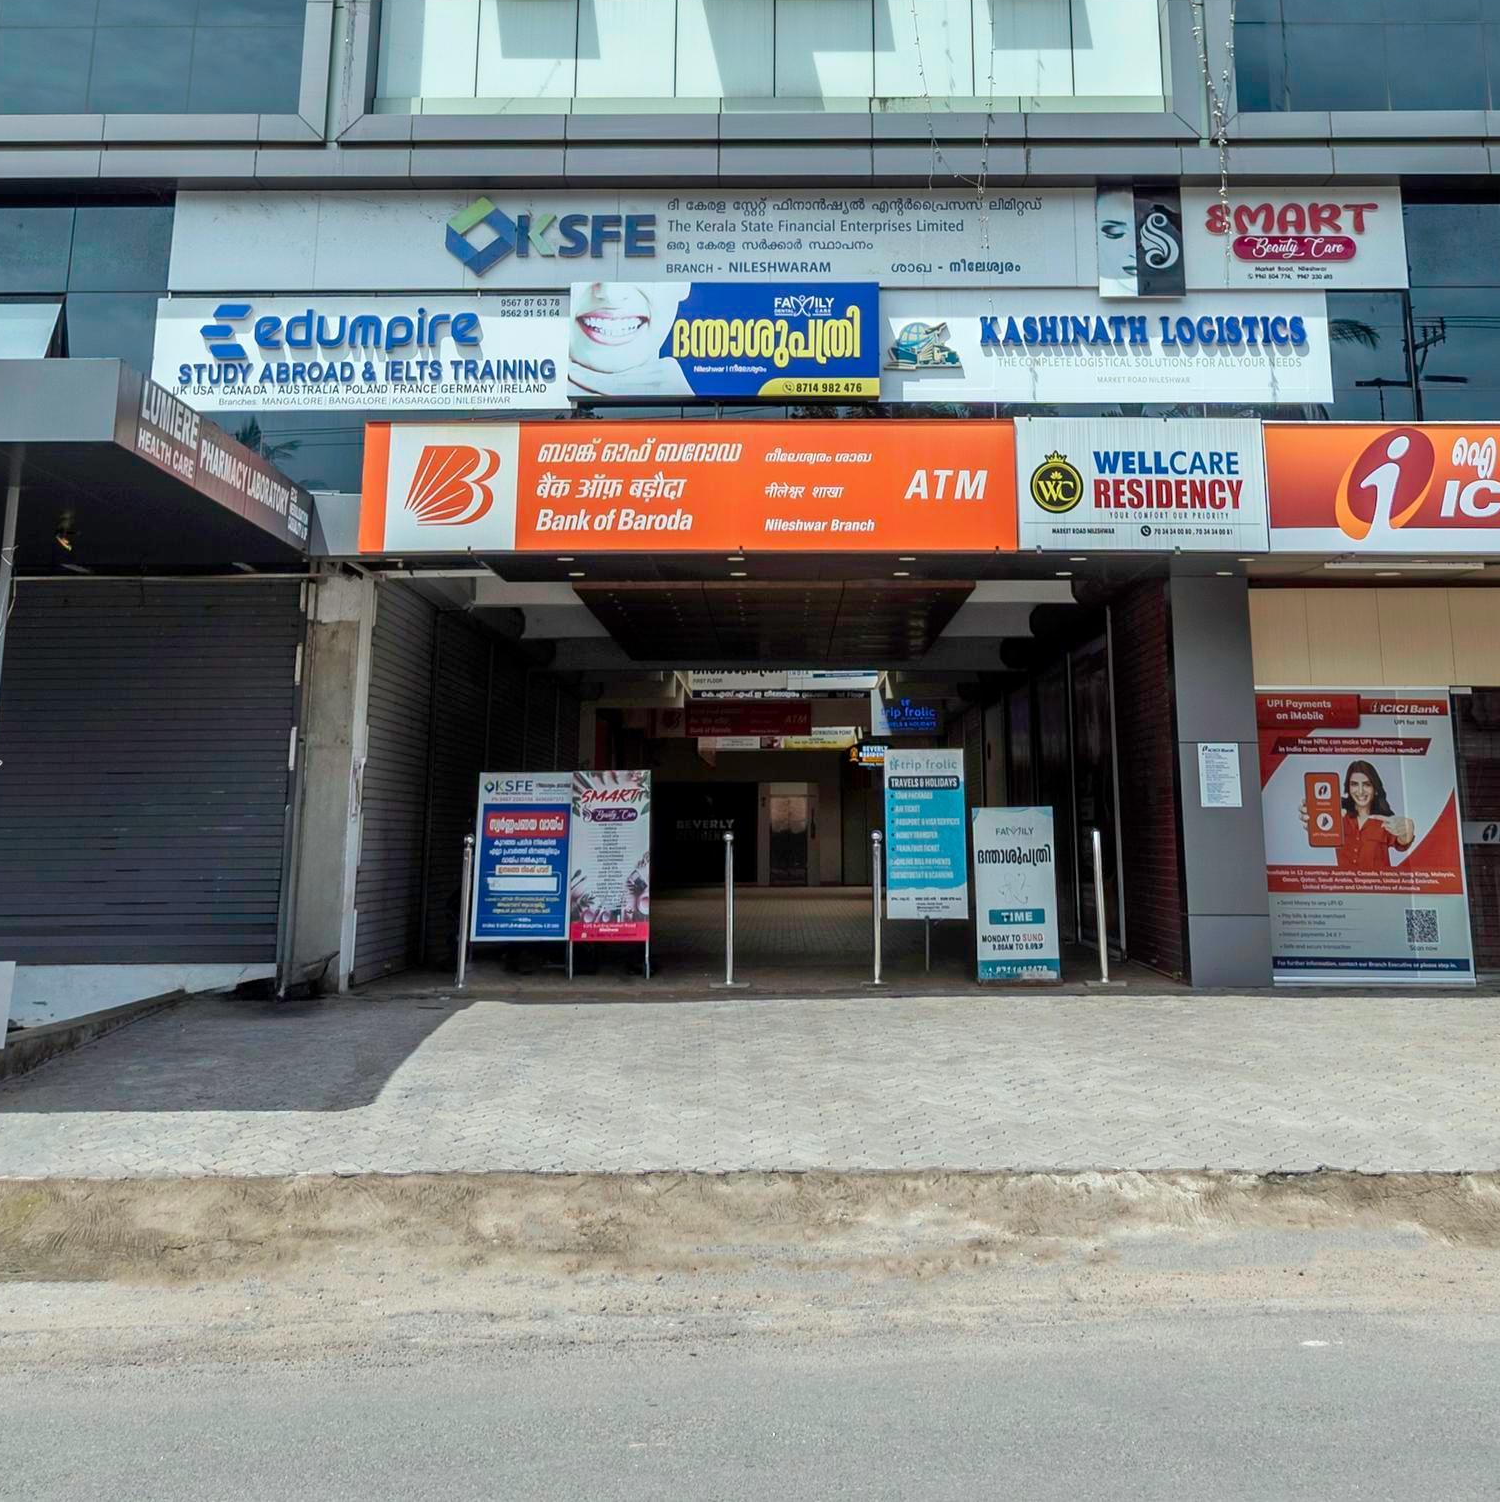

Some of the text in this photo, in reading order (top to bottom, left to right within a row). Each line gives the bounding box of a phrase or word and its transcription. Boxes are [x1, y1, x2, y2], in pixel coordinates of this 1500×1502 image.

[666, 199, 680, 211] ദി
[686, 200, 726, 214] കേരള
[1205, 202, 1379, 235] SMART
[667, 219, 964, 236] The Kerala State Financial Enterprises Limited
[515, 213, 657, 258] KSFE
[666, 241, 690, 254] ഒരു
[697, 241, 736, 252] കേരള
[1245, 237, 1345, 259] Beauty Care
[666, 261, 832, 274] BRANCH NILESHWARAM
[891, 263, 933, 274] ശാഖ
[980, 315, 1307, 347] KASHINATH LOGISTICS
[998, 357, 1302, 368] THE COMPLETE LOGISTICAL SOLUTIONS FOR ALL YOUR NEEDS
[178, 358, 556, 385] STUDY ABROAD & IELTS TRAINING
[173, 384, 547, 395] UK USA CANADA AUSTRALIA POLAND FRANCE GERMANY IRELAND
[796, 383, 863, 393] 8714 982 476
[140, 379, 200, 450] LUMIERE
[137, 427, 195, 479] HEALTH CARE
[537, 437, 601, 463] ബാങ്ക്
[601, 438, 653, 463] ഓഫ്
[1092, 450, 1240, 475] WELLCARE
[200, 439, 249, 492] PHARMACY
[247, 465, 290, 517] LABORATORY
[904, 469, 989, 500] ATM
[535, 471, 571, 499] बैंक
[629, 471, 687, 504] बड़ौदा
[811, 484, 844, 498] शाखा
[1093, 478, 1244, 510] RESIDENCY
[535, 508, 693, 532] Bank of Baroda
[764, 518, 875, 532] Nileshwar Branch
[1266, 700, 1332, 710] UPI Payments
[1379, 704, 1440, 714] ICICI Bank
[1290, 712, 1324, 721] iMobile
[926, 758, 957, 770] frolic
[495, 780, 534, 792] KSFE
[890, 778, 919, 788] TRAVELS
[925, 778, 958, 788] HOLIDAYS
[1001, 912, 1034, 922] TIME
[981, 935, 1010, 943] MONDAY
